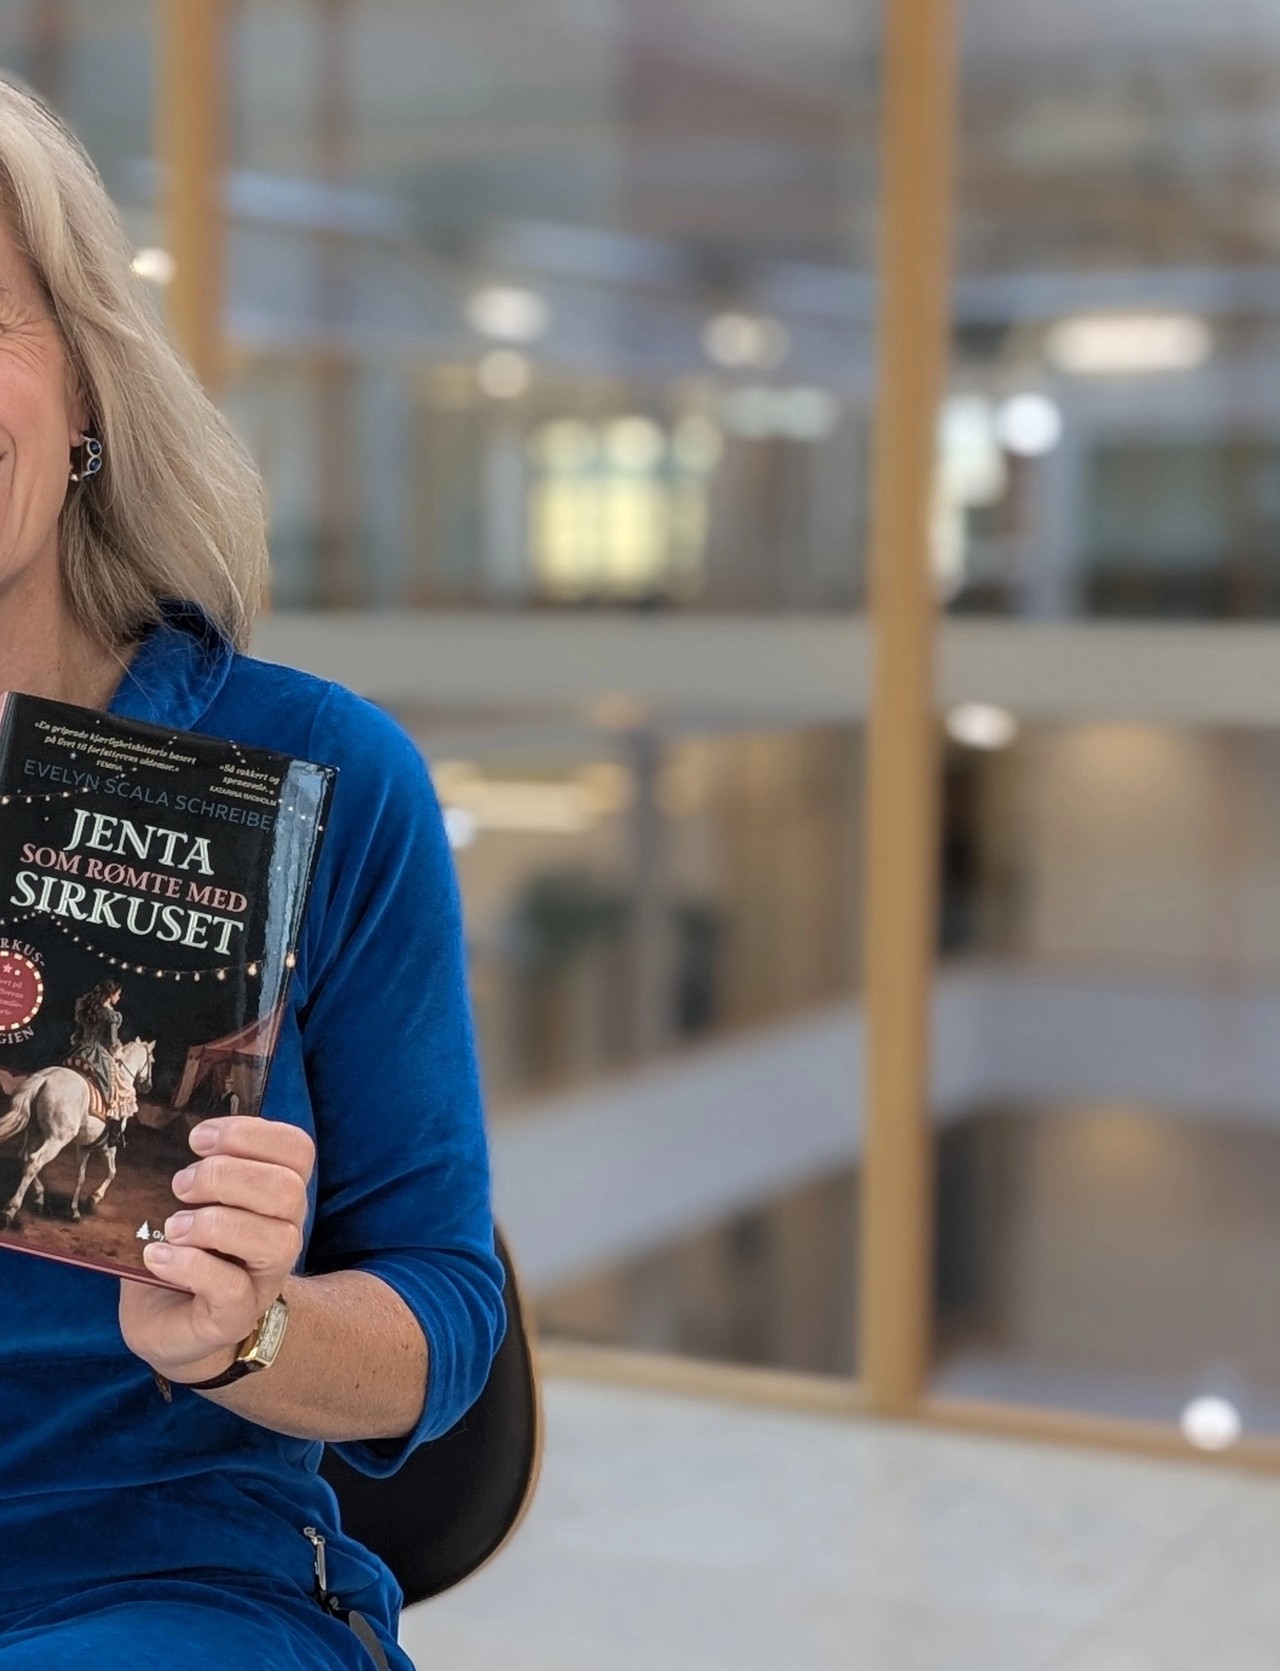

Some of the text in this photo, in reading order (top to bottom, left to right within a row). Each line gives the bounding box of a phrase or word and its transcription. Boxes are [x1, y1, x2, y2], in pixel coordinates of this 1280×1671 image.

[24, 759, 101, 790] EVELYN
[104, 778, 170, 807] SCALA
[269, 776, 280, 785] og
[63, 808, 215, 876] JENTA
[20, 843, 248, 913] SOM RØMTE MED
[10, 870, 244, 956] SIRKUSET
